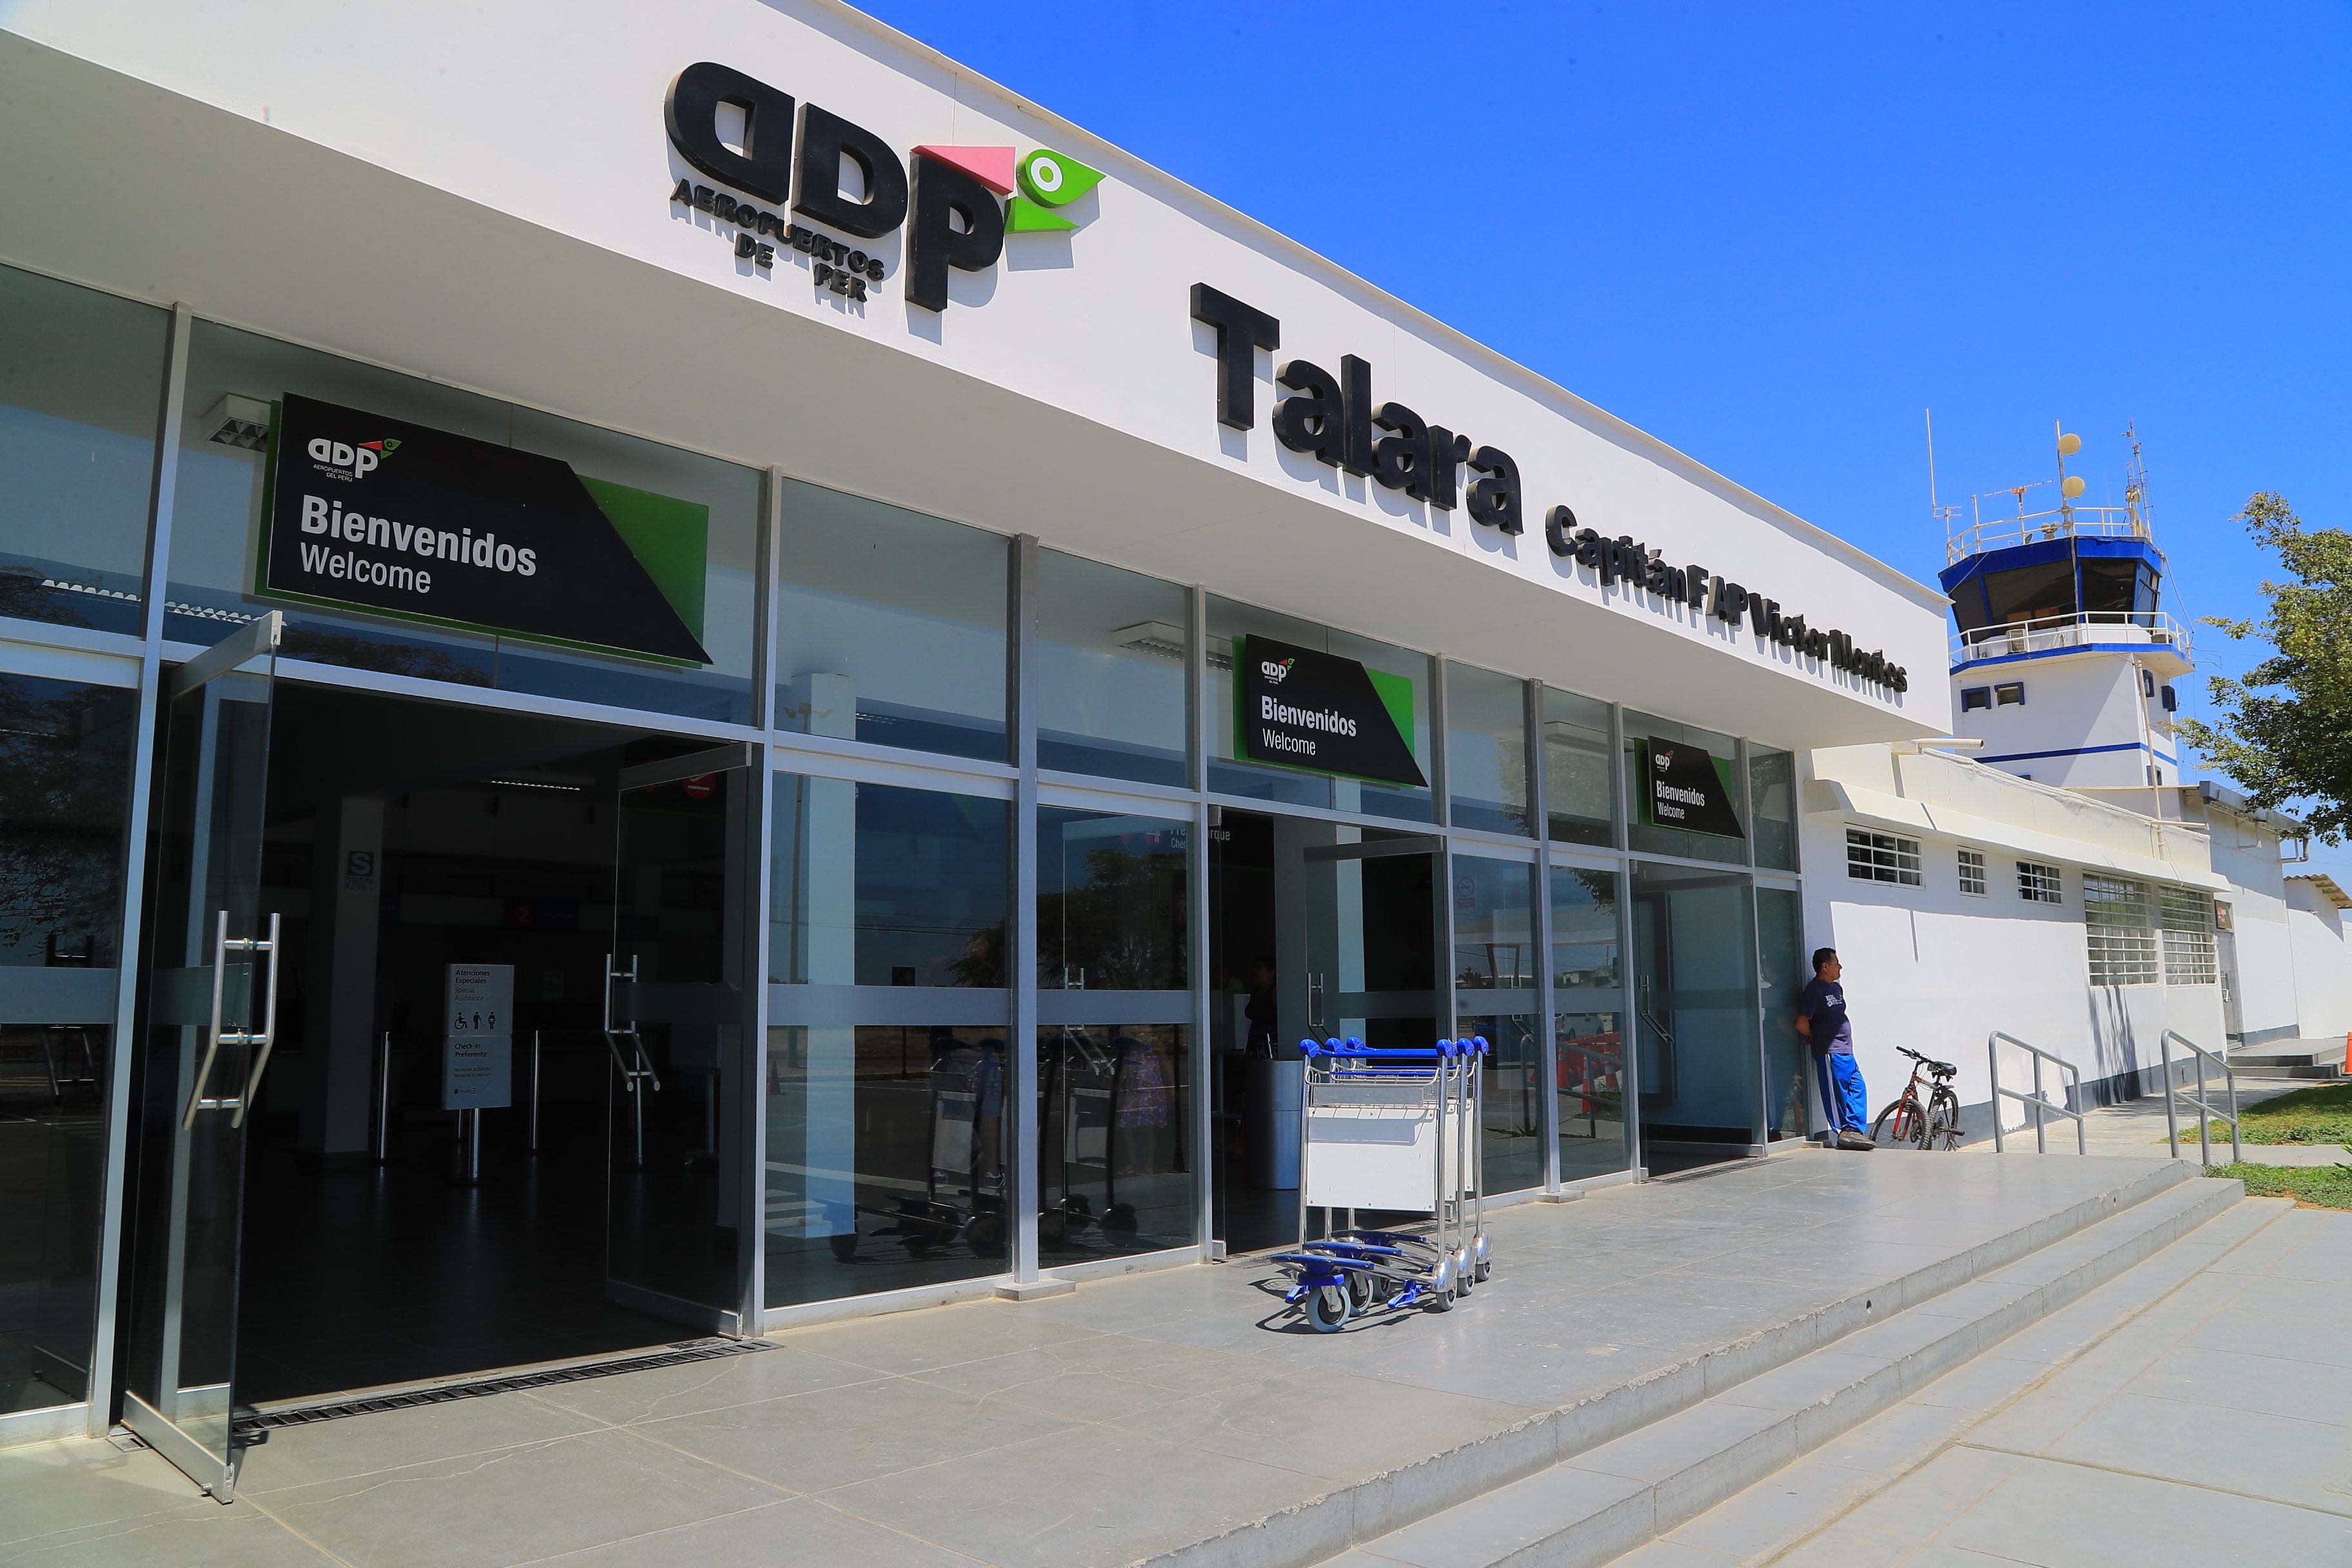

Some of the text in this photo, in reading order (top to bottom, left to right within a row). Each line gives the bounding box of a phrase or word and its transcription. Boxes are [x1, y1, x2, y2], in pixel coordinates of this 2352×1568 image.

[670, 178, 885, 282] AEROPUERTOS
[734, 232, 868, 302] DE PER
[1190, 282, 1524, 535] Talara
[313, 464, 353, 477] AEROPUERTOS
[301, 495, 536, 576] Bienvenidos
[300, 541, 431, 594] Welcome
[1545, 505, 1687, 603] Capitán
[1685, 564, 1749, 627] FAP
[1828, 629, 1908, 692] Montes
[1261, 695, 1357, 737] Bienvenidos
[1262, 728, 1317, 756] Welcome
[1656, 779, 1705, 807] Bienvenidos
[1657, 801, 1685, 819] Welcome
[1208, 829, 1230, 843] rque
[351, 853, 371, 874] S
[518, 907, 529, 923] 2
